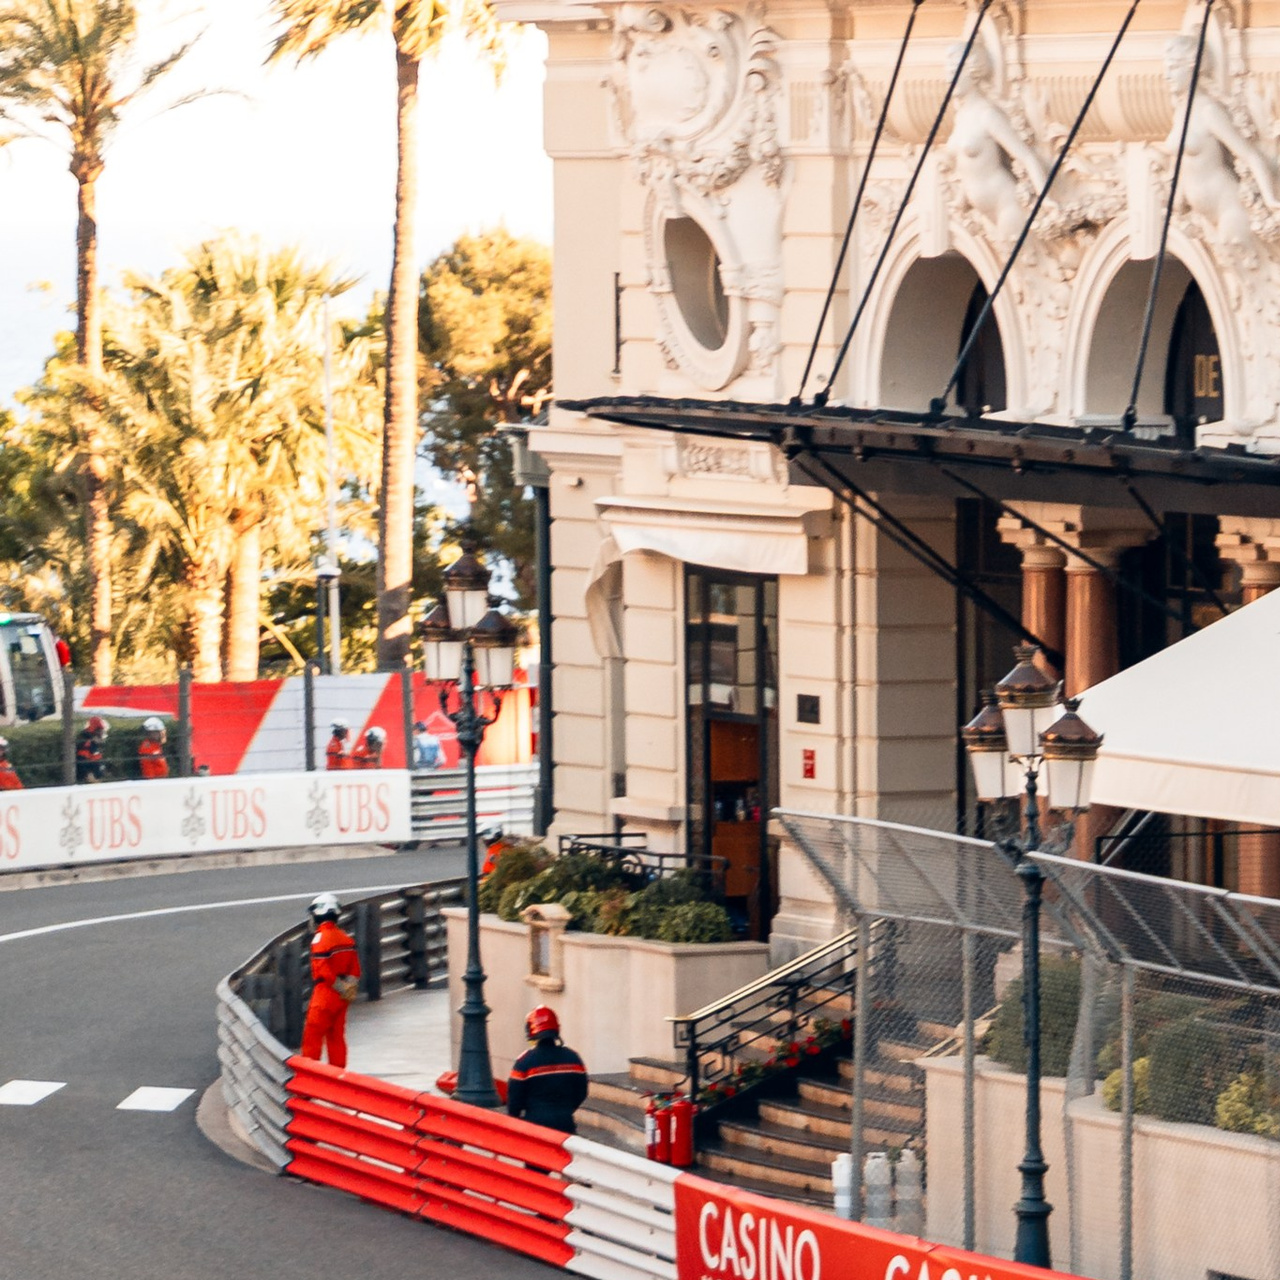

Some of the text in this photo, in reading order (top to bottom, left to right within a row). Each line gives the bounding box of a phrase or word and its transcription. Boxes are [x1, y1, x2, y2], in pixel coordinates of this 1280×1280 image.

[87, 795, 142, 850] UBS
[210, 788, 266, 841] UBS
[334, 783, 391, 833] UBS
